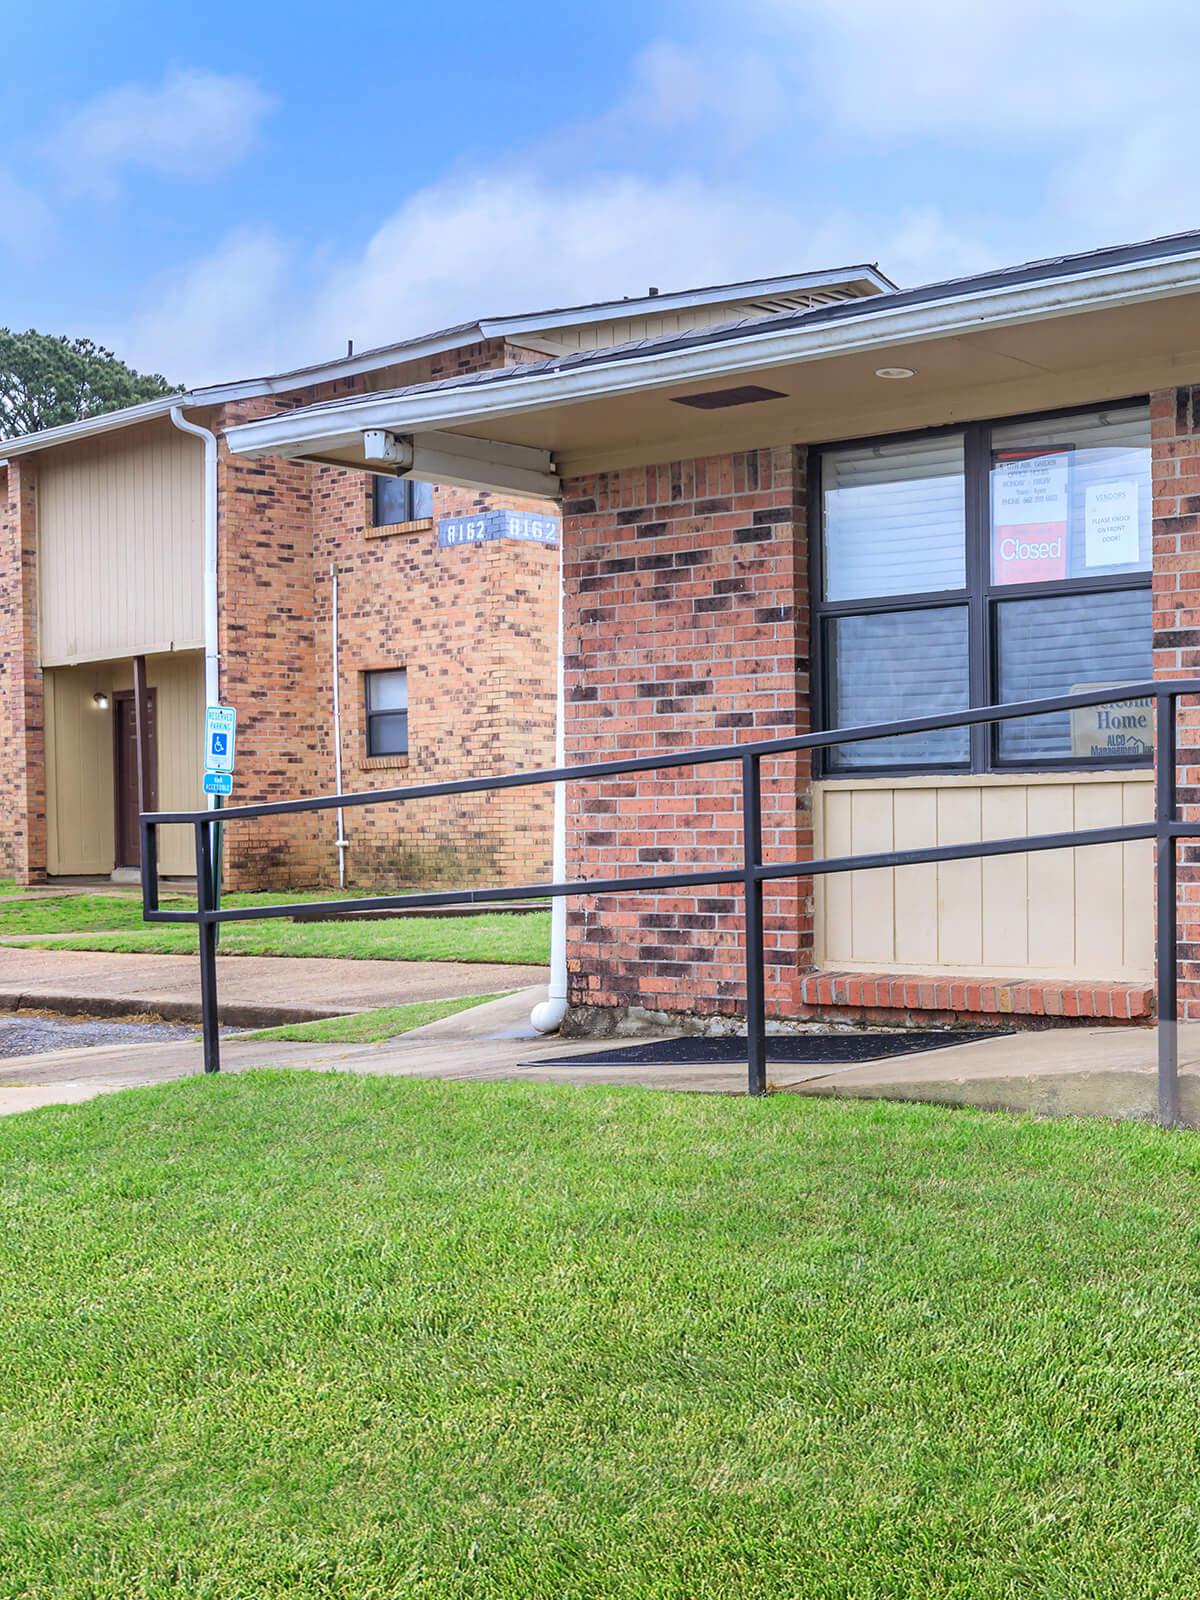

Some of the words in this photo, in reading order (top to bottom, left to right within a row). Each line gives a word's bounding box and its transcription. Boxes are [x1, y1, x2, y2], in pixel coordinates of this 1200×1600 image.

[447, 520, 486, 544] 8162
[509, 518, 556, 541] 8162
[1000, 535, 1063, 560] Closed
[1096, 710, 1147, 730] Home
[1107, 734, 1126, 746] ALCO
